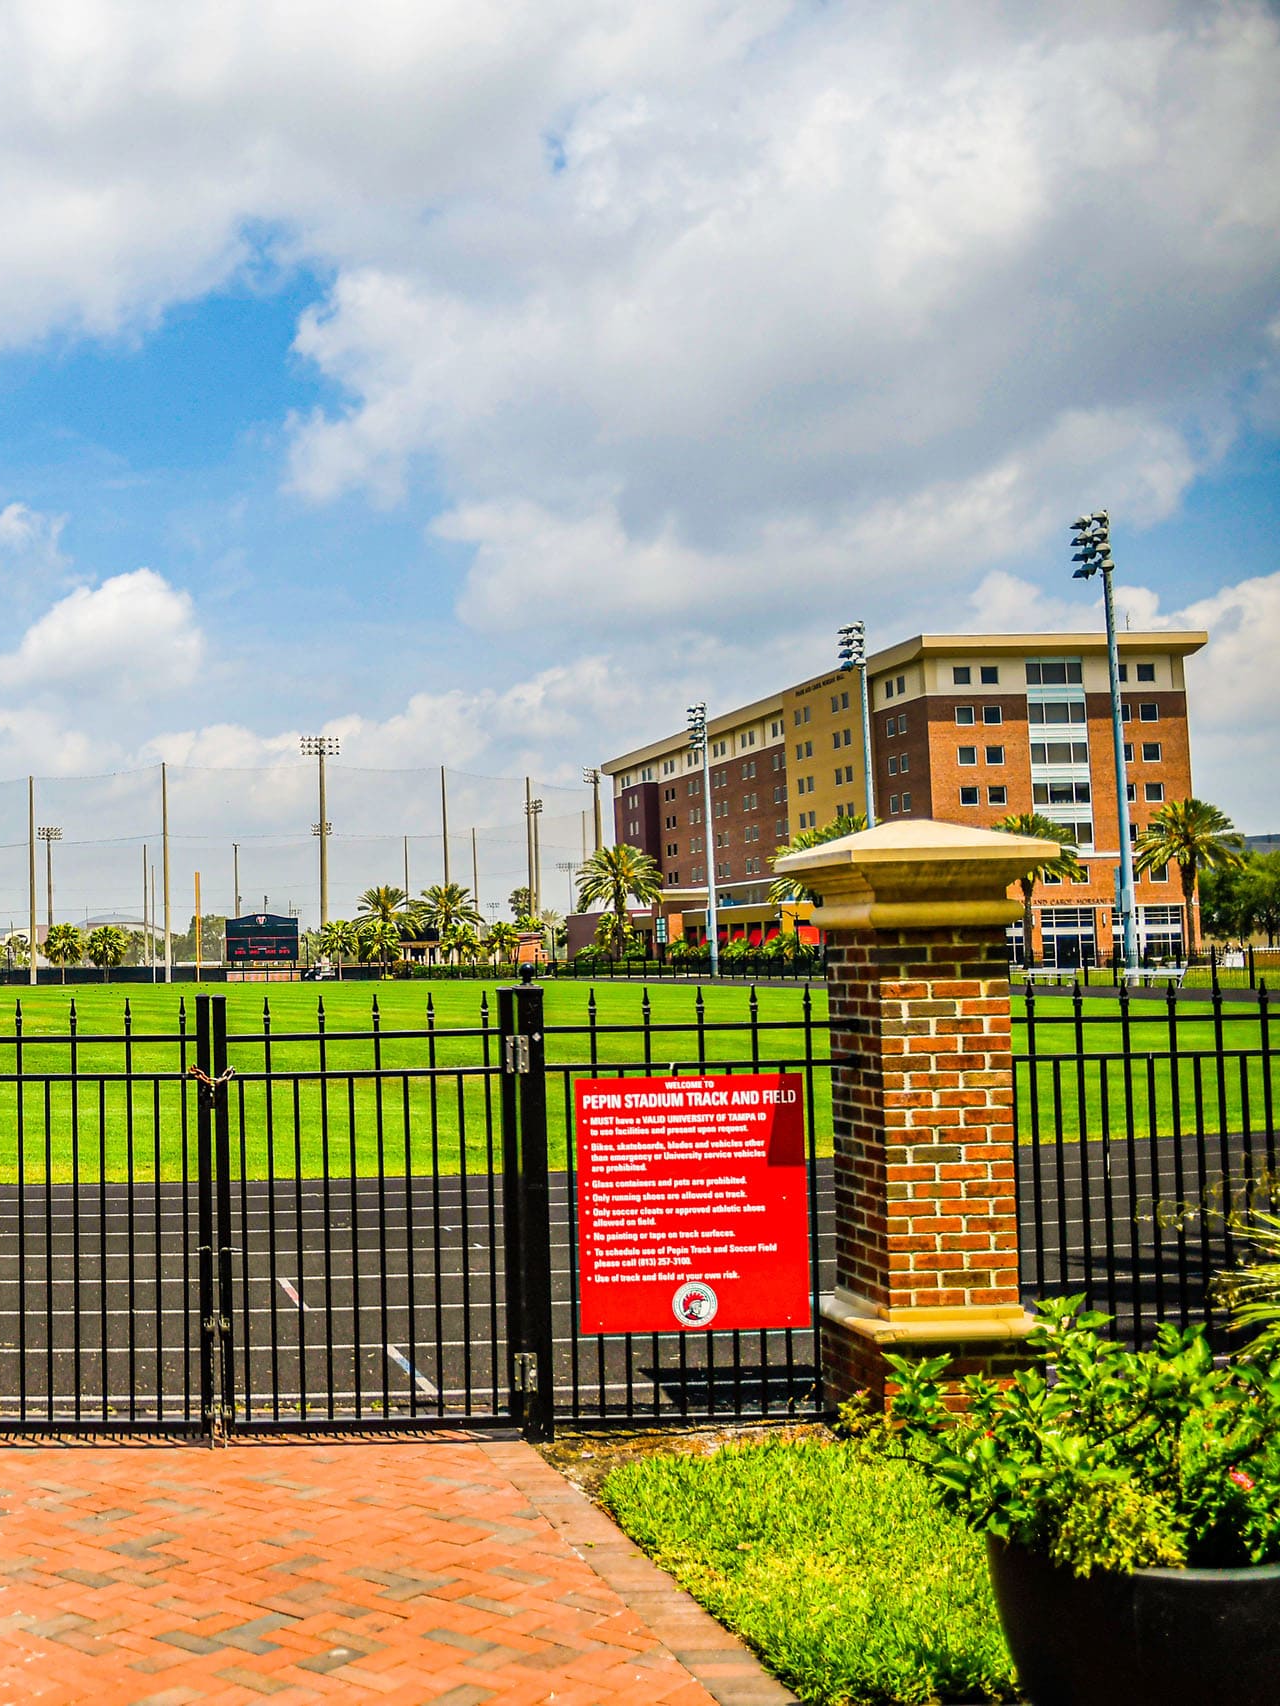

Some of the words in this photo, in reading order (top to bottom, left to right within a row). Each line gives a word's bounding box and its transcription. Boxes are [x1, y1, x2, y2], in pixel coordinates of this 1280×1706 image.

[665, 1080, 702, 1090] WELCOME
[704, 1080, 714, 1088] TO
[583, 1094, 622, 1110] PEPIN
[624, 1092, 684, 1109] STADIUM
[686, 1091, 728, 1107] TRACK
[731, 1090, 760, 1105] AND
[762, 1089, 796, 1104] FIELD
[590, 1116, 614, 1126] MUST
[615, 1116, 634, 1125] have
[642, 1115, 666, 1124] VALID
[667, 1113, 715, 1124] UNIVERSITY
[716, 1113, 726, 1122] OF
[728, 1112, 756, 1122] TAMPA
[757, 1112, 766, 1121] ID
[590, 1128, 599, 1136] to
[615, 1126, 650, 1136] facilities
[651, 1126, 666, 1134] and
[667, 1126, 696, 1135] present
[697, 1126, 716, 1134] upon
[667, 1140, 693, 1149] blades
[694, 1140, 709, 1149] and
[710, 1139, 743, 1148] vehicles
[744, 1138, 764, 1147] other
[591, 1153, 609, 1162] than
[610, 1154, 652, 1162] emergency
[664, 1150, 702, 1161] University
[704, 1150, 732, 1159] service
[733, 1149, 766, 1158] vehicles
[592, 1180, 614, 1189] Glass
[615, 1178, 656, 1188] containers
[658, 1178, 672, 1187] and
[674, 1178, 690, 1188] pets
[592, 1193, 610, 1203] Only
[611, 1192, 641, 1203] running
[642, 1192, 665, 1201] shoes
[681, 1190, 713, 1200] allowed
[593, 1208, 611, 1218] Only
[640, 1206, 664, 1215] cleats
[675, 1205, 711, 1215] approved
[712, 1204, 741, 1213] athletic
[743, 1203, 766, 1212] shoes
[593, 1218, 625, 1227] allowed
[593, 1233, 605, 1241] No
[606, 1232, 638, 1242] painting
[649, 1231, 666, 1241] tape
[679, 1230, 699, 1238] track
[594, 1248, 604, 1257] To
[605, 1247, 640, 1256] schedule
[657, 1246, 665, 1255] of
[666, 1245, 689, 1255] Pepin
[690, 1245, 712, 1254] Track
[713, 1244, 728, 1253] and
[729, 1244, 757, 1253] Soccer
[758, 1243, 777, 1252] Field
[594, 1258, 620, 1268] please
[622, 1258, 637, 1267] call
[594, 1274, 610, 1283] Use
[611, 1274, 619, 1282] of
[620, 1273, 640, 1282] track
[642, 1272, 657, 1281] and
[658, 1272, 675, 1281] field
